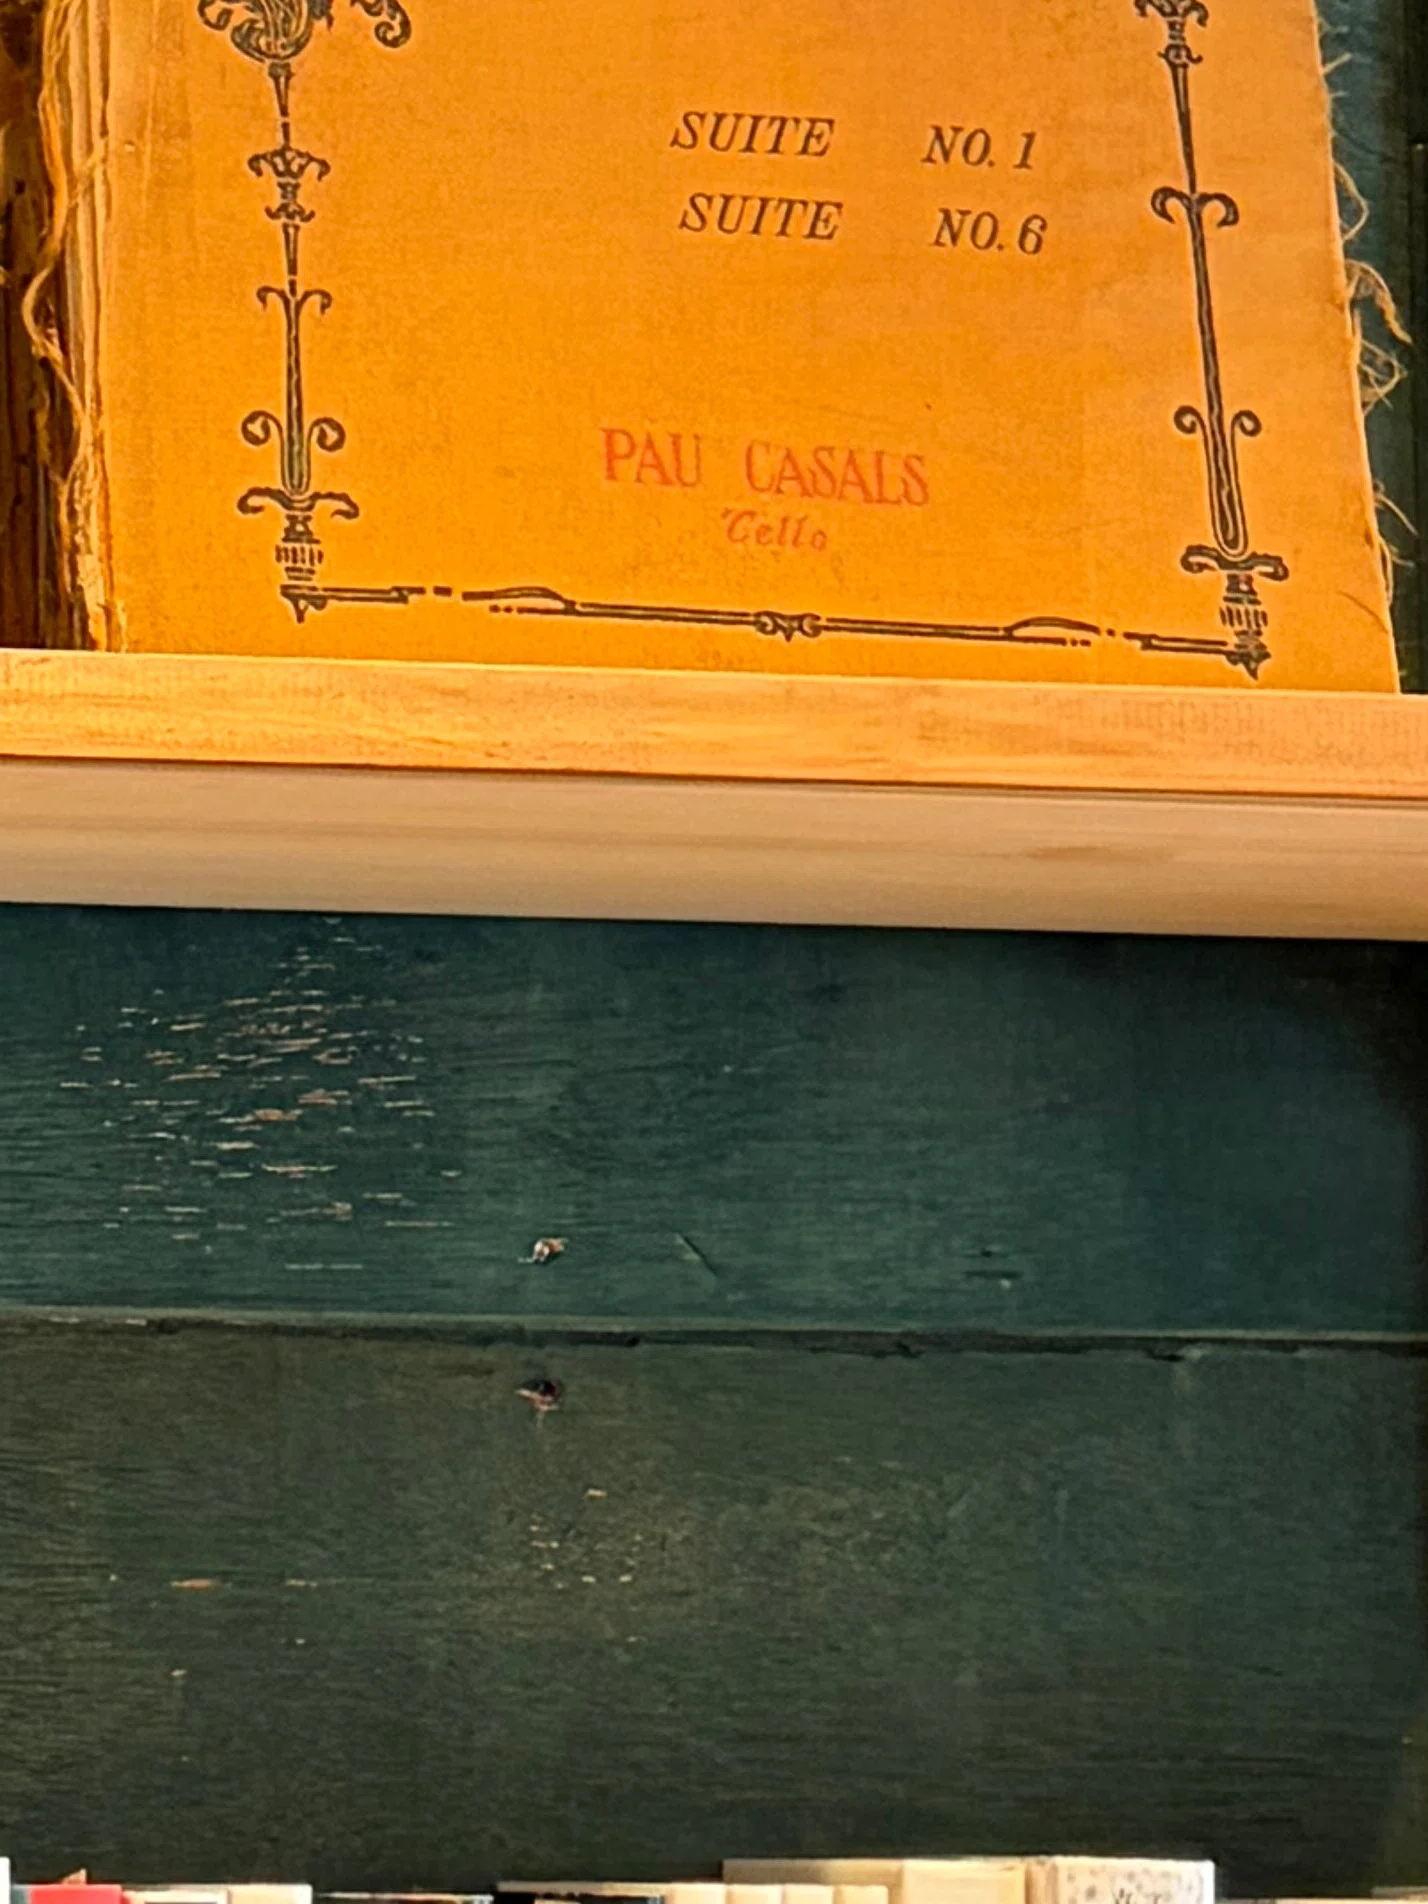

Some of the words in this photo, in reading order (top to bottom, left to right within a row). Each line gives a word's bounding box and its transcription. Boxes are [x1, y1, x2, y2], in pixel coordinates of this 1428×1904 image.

[670, 108, 836, 162] SUITE
[921, 122, 1004, 171] NO.
[678, 190, 844, 243] SUITE
[600, 427, 703, 489] PAU
[744, 441, 931, 509] CASALS
[721, 506, 829, 554] Cello
